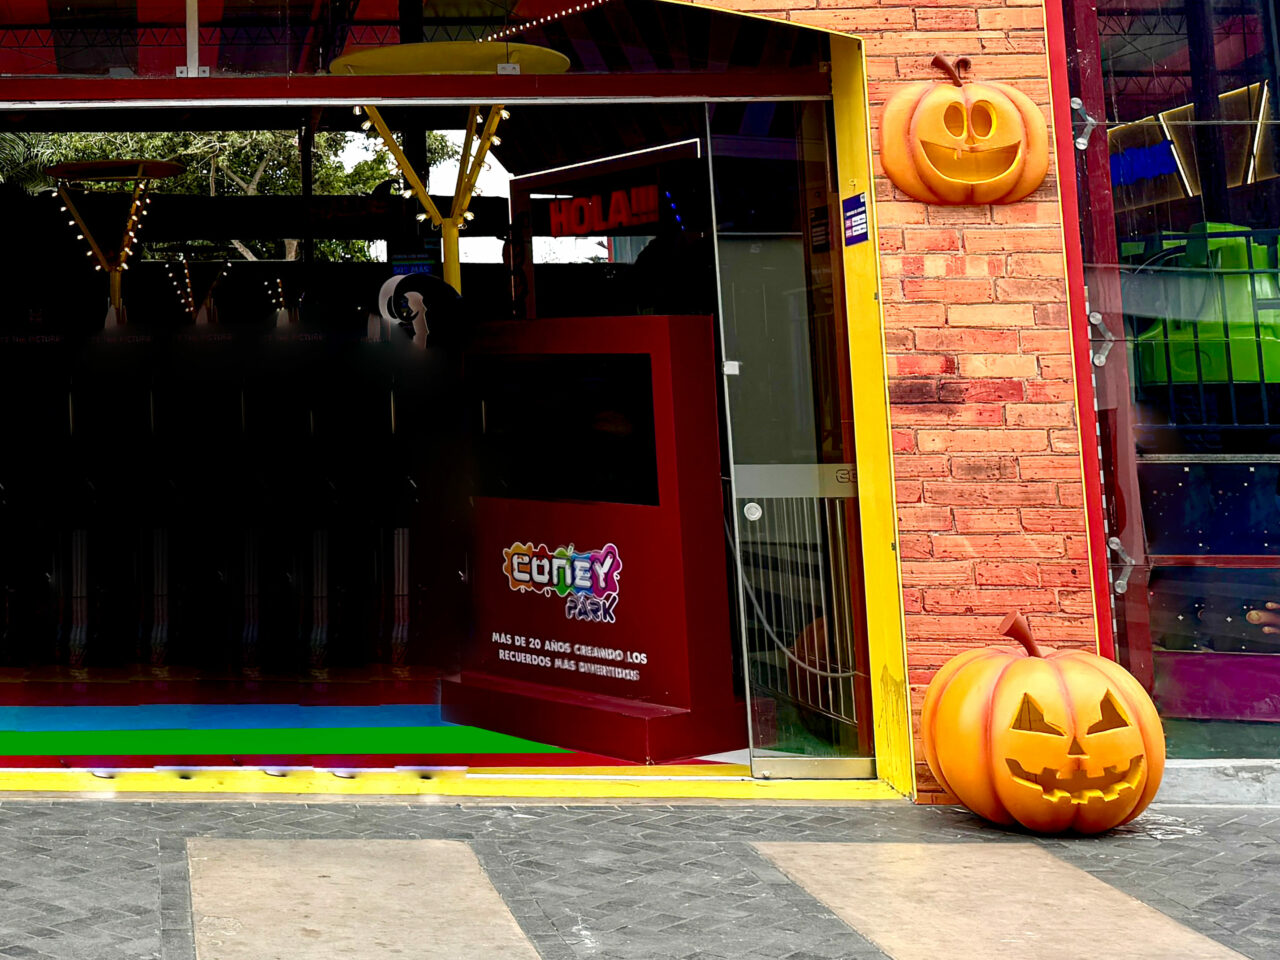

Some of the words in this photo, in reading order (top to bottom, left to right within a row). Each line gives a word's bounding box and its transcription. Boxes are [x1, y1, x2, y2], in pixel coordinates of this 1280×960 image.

[549, 185, 659, 238] HOLA!!!
[512, 550, 616, 589] CONEY
[566, 592, 619, 623] PARK
[499, 649, 552, 668] RECUERDOS
[578, 661, 640, 681] DIVERTIDOS
[514, 635, 526, 647] DE
[529, 638, 541, 649] 20
[544, 639, 571, 653] AÑOS
[573, 644, 624, 661] CREANDO
[626, 651, 648, 664] LOS
